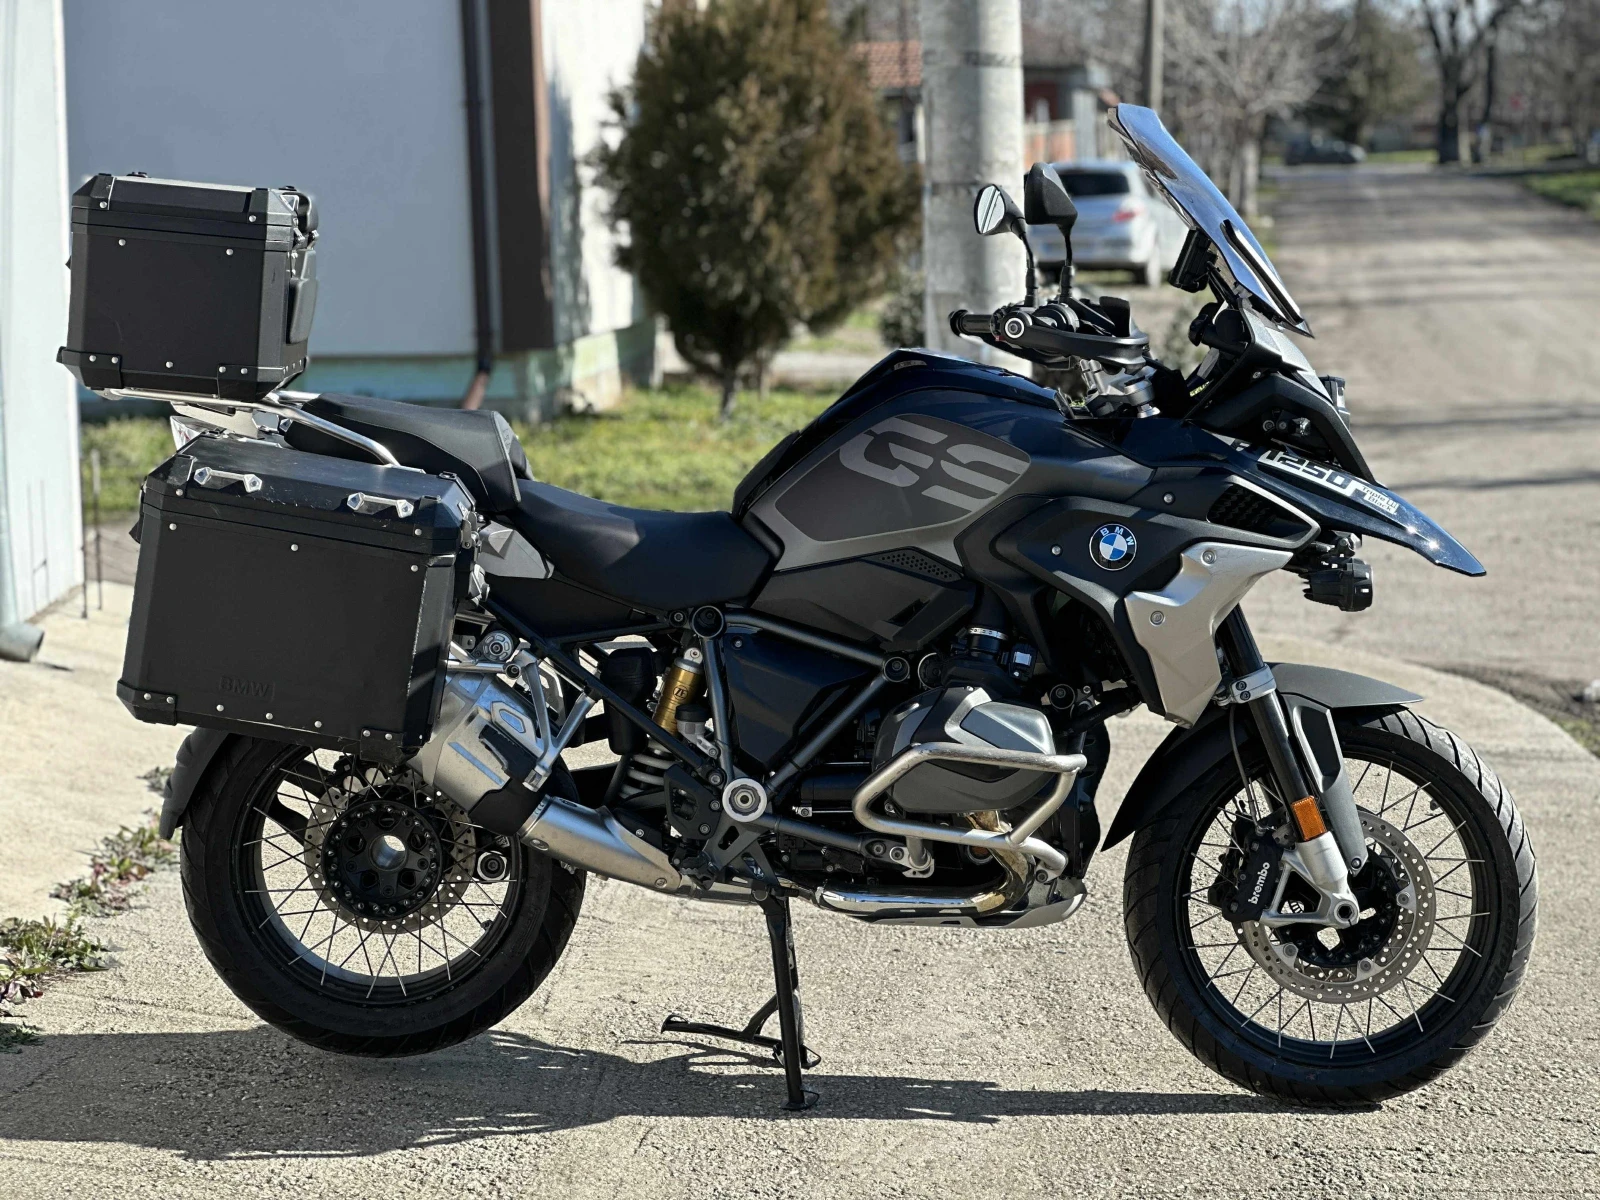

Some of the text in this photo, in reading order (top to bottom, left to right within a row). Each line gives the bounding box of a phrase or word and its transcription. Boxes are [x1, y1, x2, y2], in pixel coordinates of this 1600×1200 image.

[840, 417, 1030, 512] GS
[1266, 450, 1352, 490] 1250
[1362, 486, 1386, 502] Triple
[1368, 495, 1392, 512] Black
[1100, 526, 1135, 546] BMW
[218, 676, 269, 698] BMW
[1248, 862, 1270, 905] brembo
